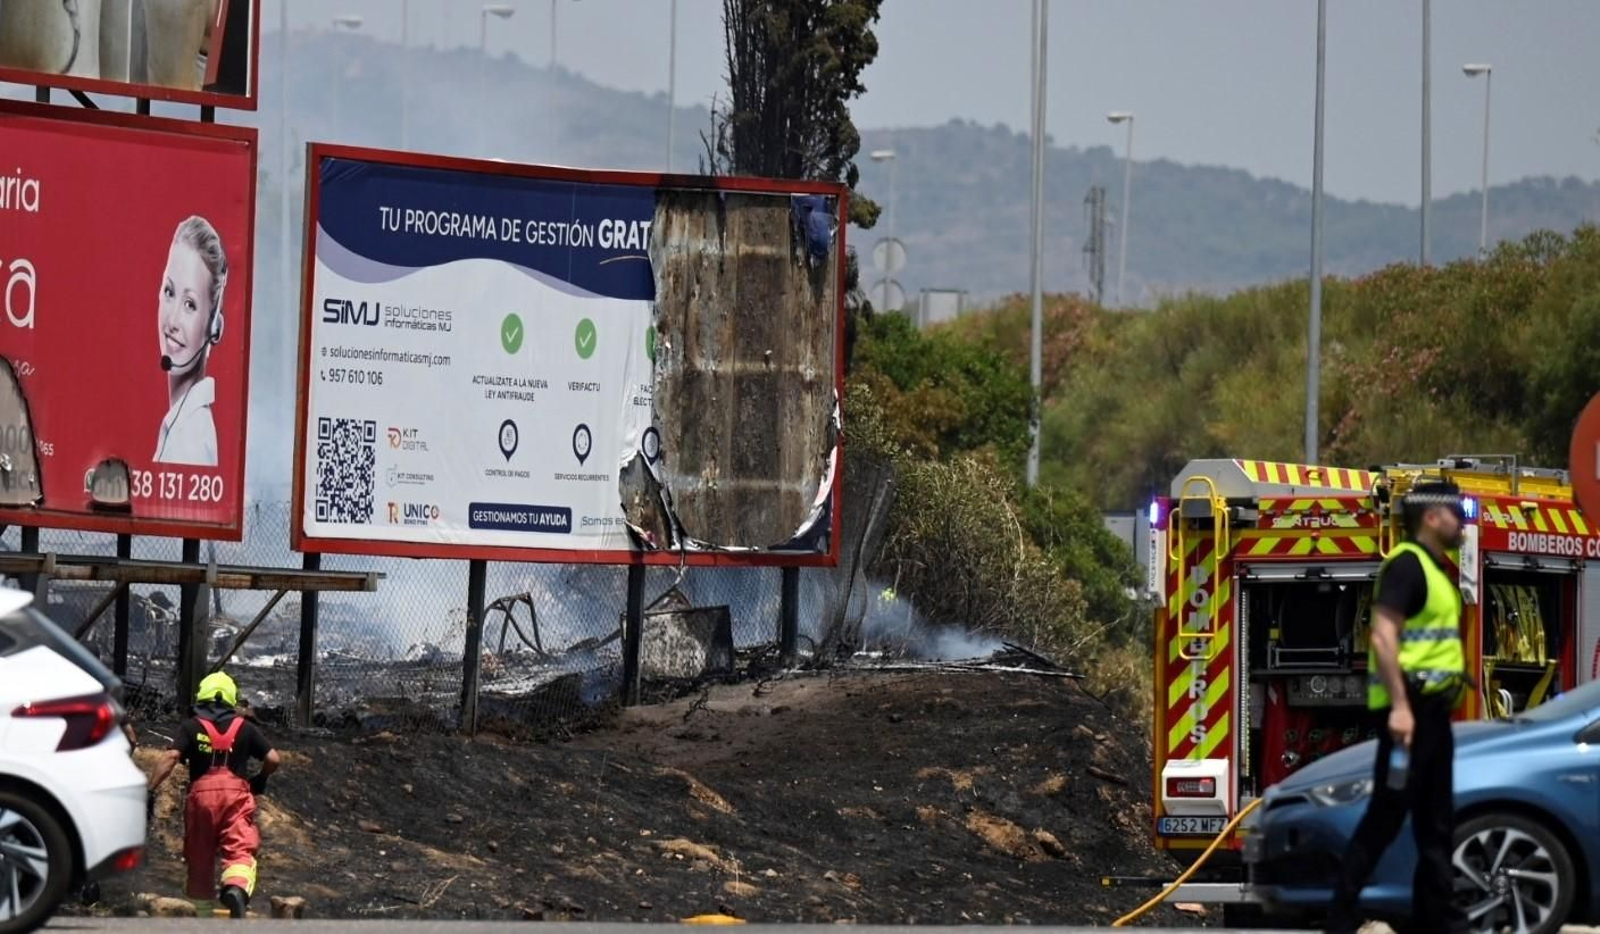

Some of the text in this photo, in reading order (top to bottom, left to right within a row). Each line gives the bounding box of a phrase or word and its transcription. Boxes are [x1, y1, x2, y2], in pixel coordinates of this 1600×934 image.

[379, 206, 652, 250] TU PROGRAMA DE GESTIÓN GRAT
[0, 257, 36, 329] a
[384, 305, 452, 321] soluciones
[384, 318, 452, 332] informáticas MJ
[330, 346, 451, 368] solucionesinformaticasmj.com
[328, 368, 383, 385] 957 610 106
[527, 378, 549, 390] NUEVA
[567, 381, 600, 392] VERIFACTU
[485, 389, 535, 402] LEY ANTIFRAUDE
[402, 428, 418, 438] KIT
[159, 472, 183, 499] 131
[188, 474, 223, 502] 280
[473, 510, 567, 526] GESTIONAMOS TU AYUDA
[1508, 532, 1583, 556] BOMBEROS
[1164, 818, 1225, 833] 6252 MFZ
